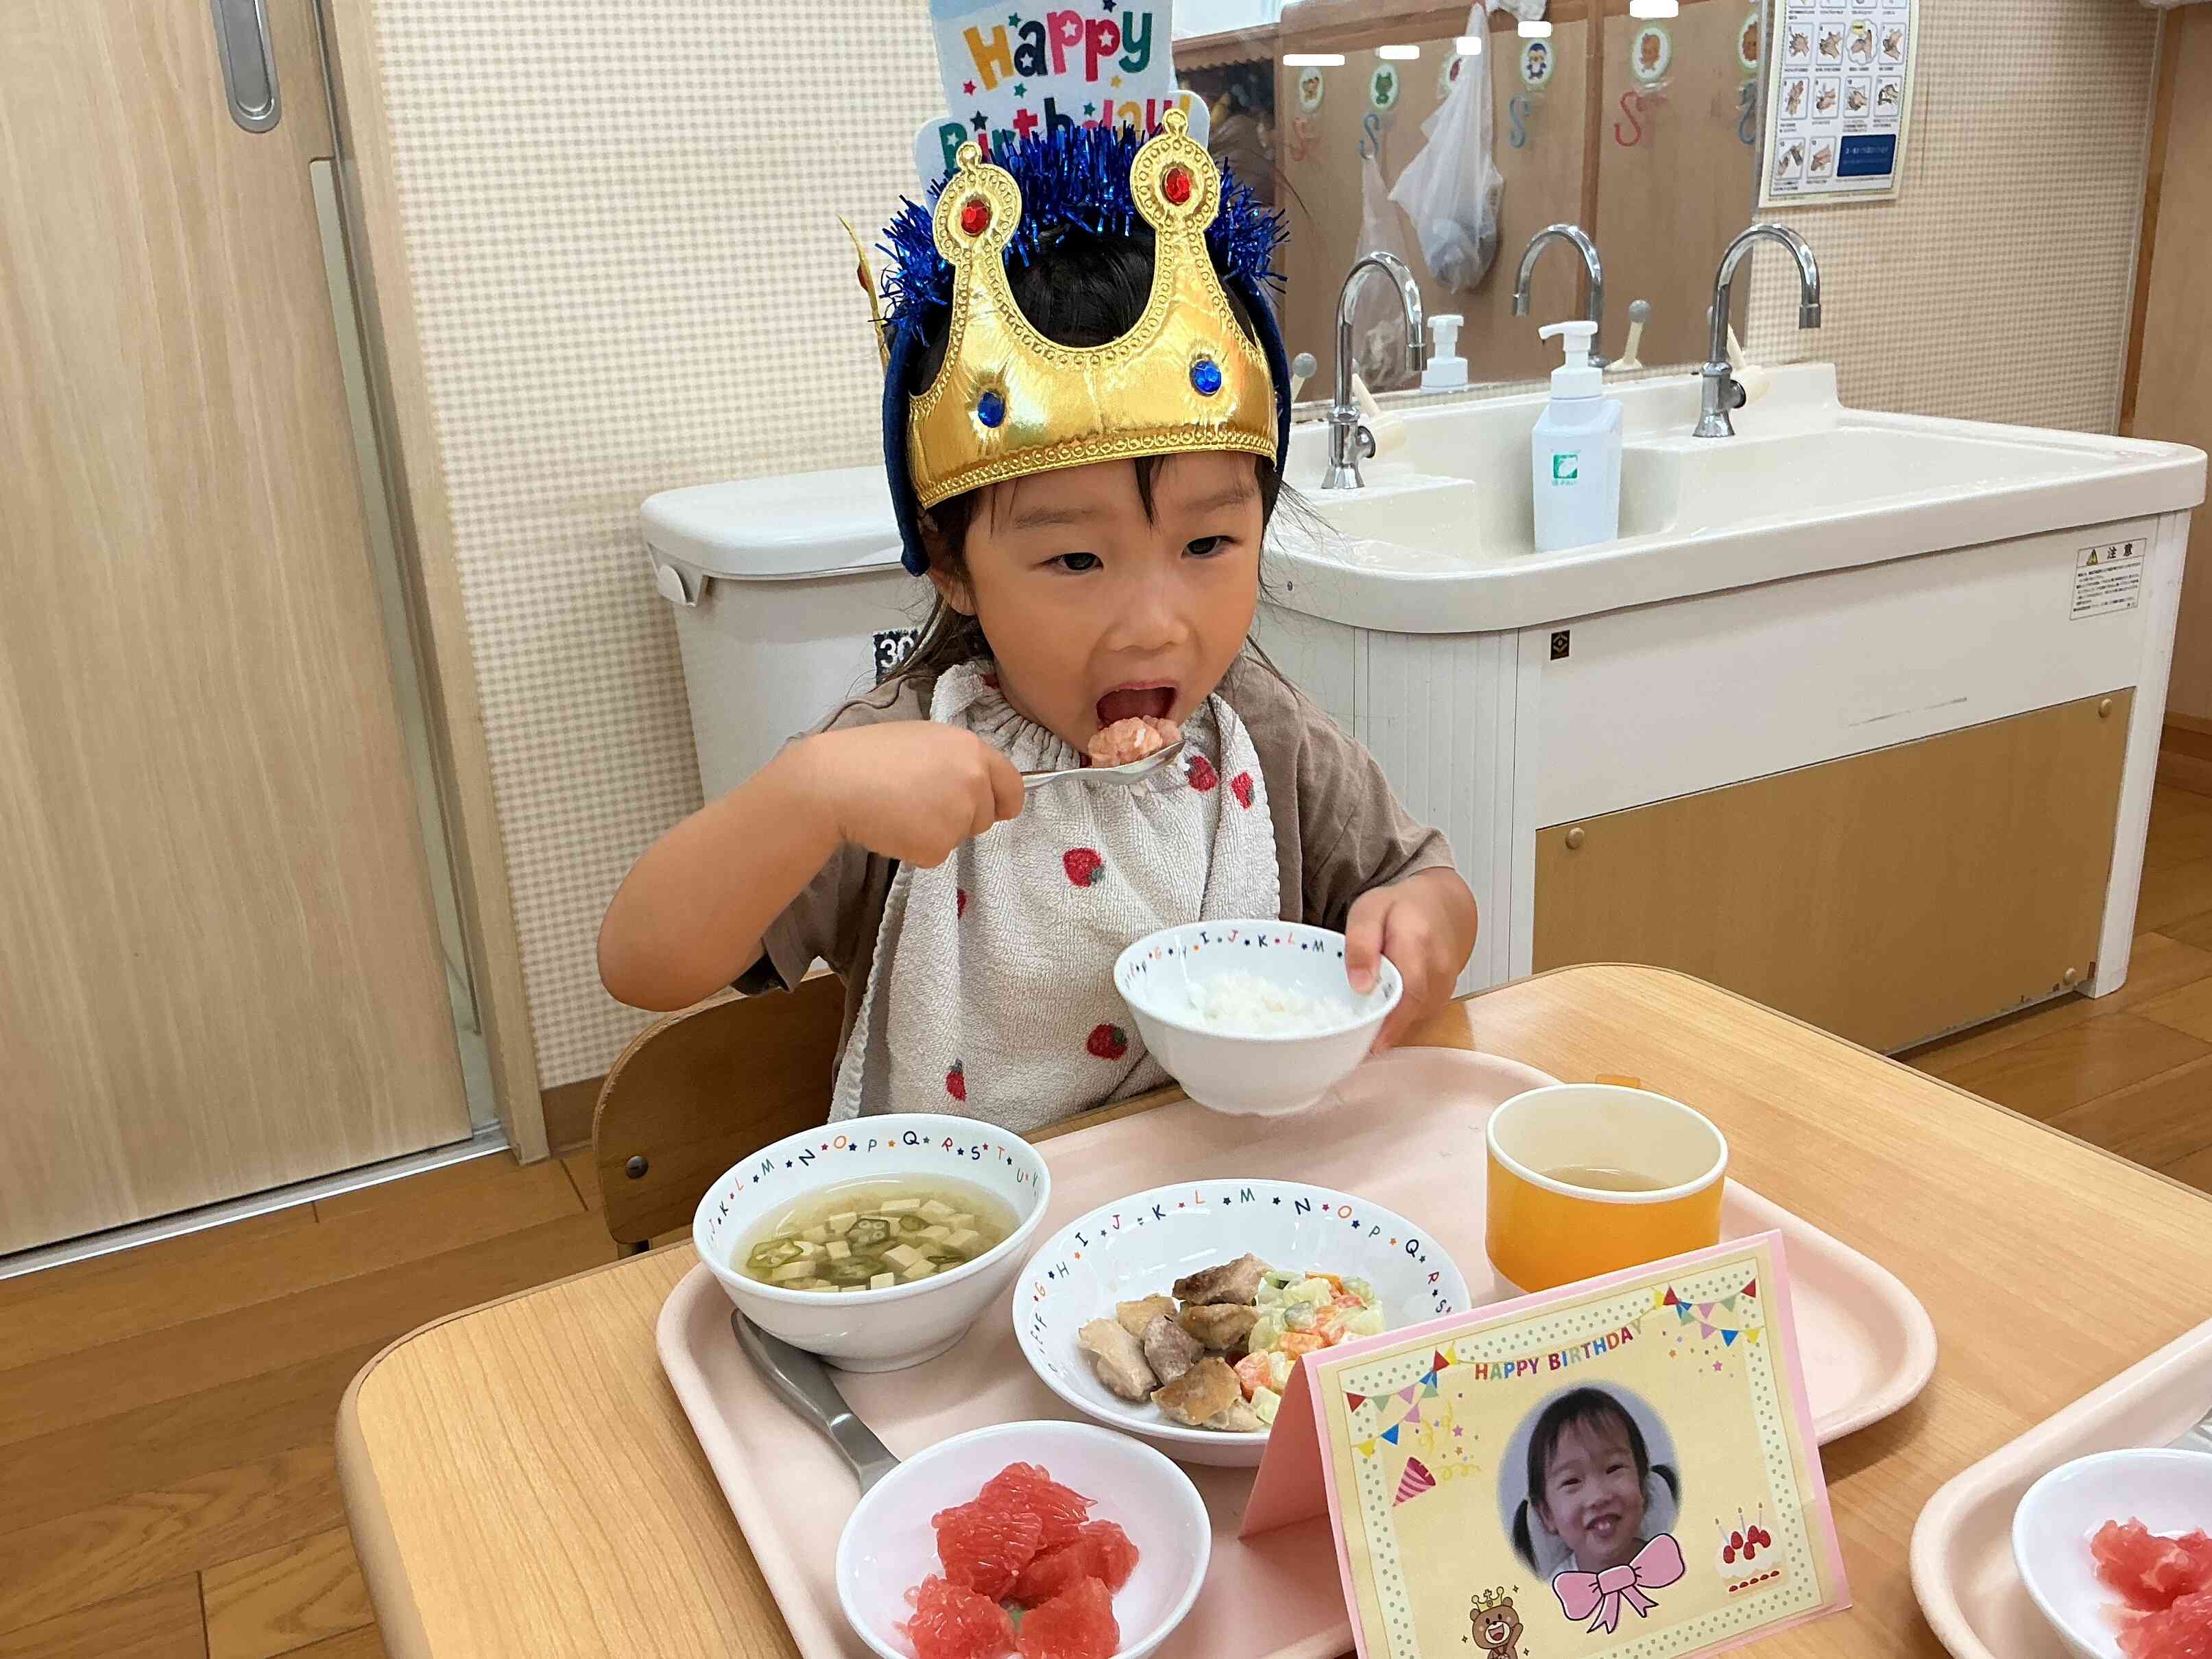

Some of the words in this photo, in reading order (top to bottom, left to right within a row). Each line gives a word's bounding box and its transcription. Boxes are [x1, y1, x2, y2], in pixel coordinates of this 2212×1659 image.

[963, 10, 1153, 92] Happy
[1258, 934, 1269, 948] K
[761, 1158, 776, 1176] M
[798, 1148, 816, 1166] N
[833, 1135, 847, 1149] O
[867, 1139, 878, 1152] P
[902, 1130, 920, 1146] Q
[941, 1137, 953, 1152] R
[971, 1146, 981, 1160] S
[1112, 1214, 1120, 1229] J
[1152, 1204, 1166, 1220] K
[1195, 1189, 1205, 1204] L
[1240, 1187, 1255, 1203] M
[1295, 1198, 1311, 1215] N
[1338, 1205, 1352, 1218] O
[1368, 1226, 1380, 1237] P
[1405, 1239, 1419, 1258] Q
[1474, 1356, 1539, 1382] HAPPY
[1548, 1316, 1642, 1371] BIRTHDAY
